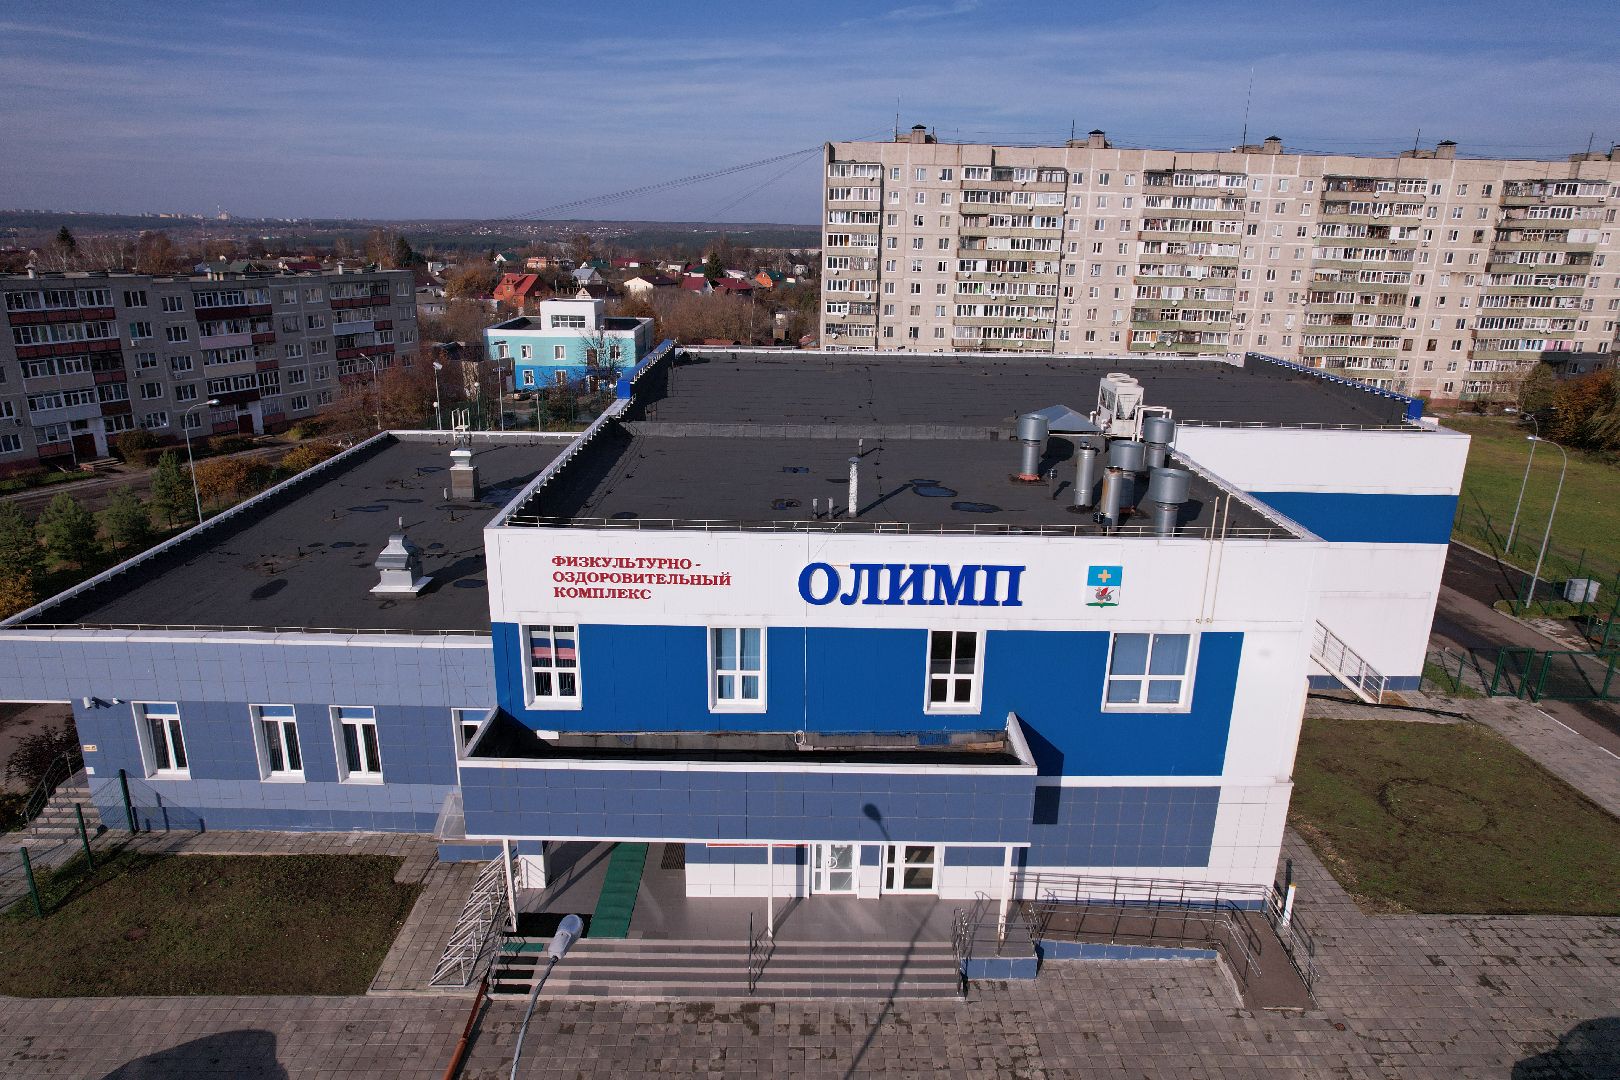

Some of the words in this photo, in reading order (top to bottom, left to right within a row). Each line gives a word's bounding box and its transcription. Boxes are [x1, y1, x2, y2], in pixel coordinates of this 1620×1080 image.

[552, 571, 731, 587] ОЗДОРОВИТЕЛЬНЫЙ
[799, 562, 1026, 606] ОЛИМП
[553, 586, 652, 600] КОМПЛЕКС
